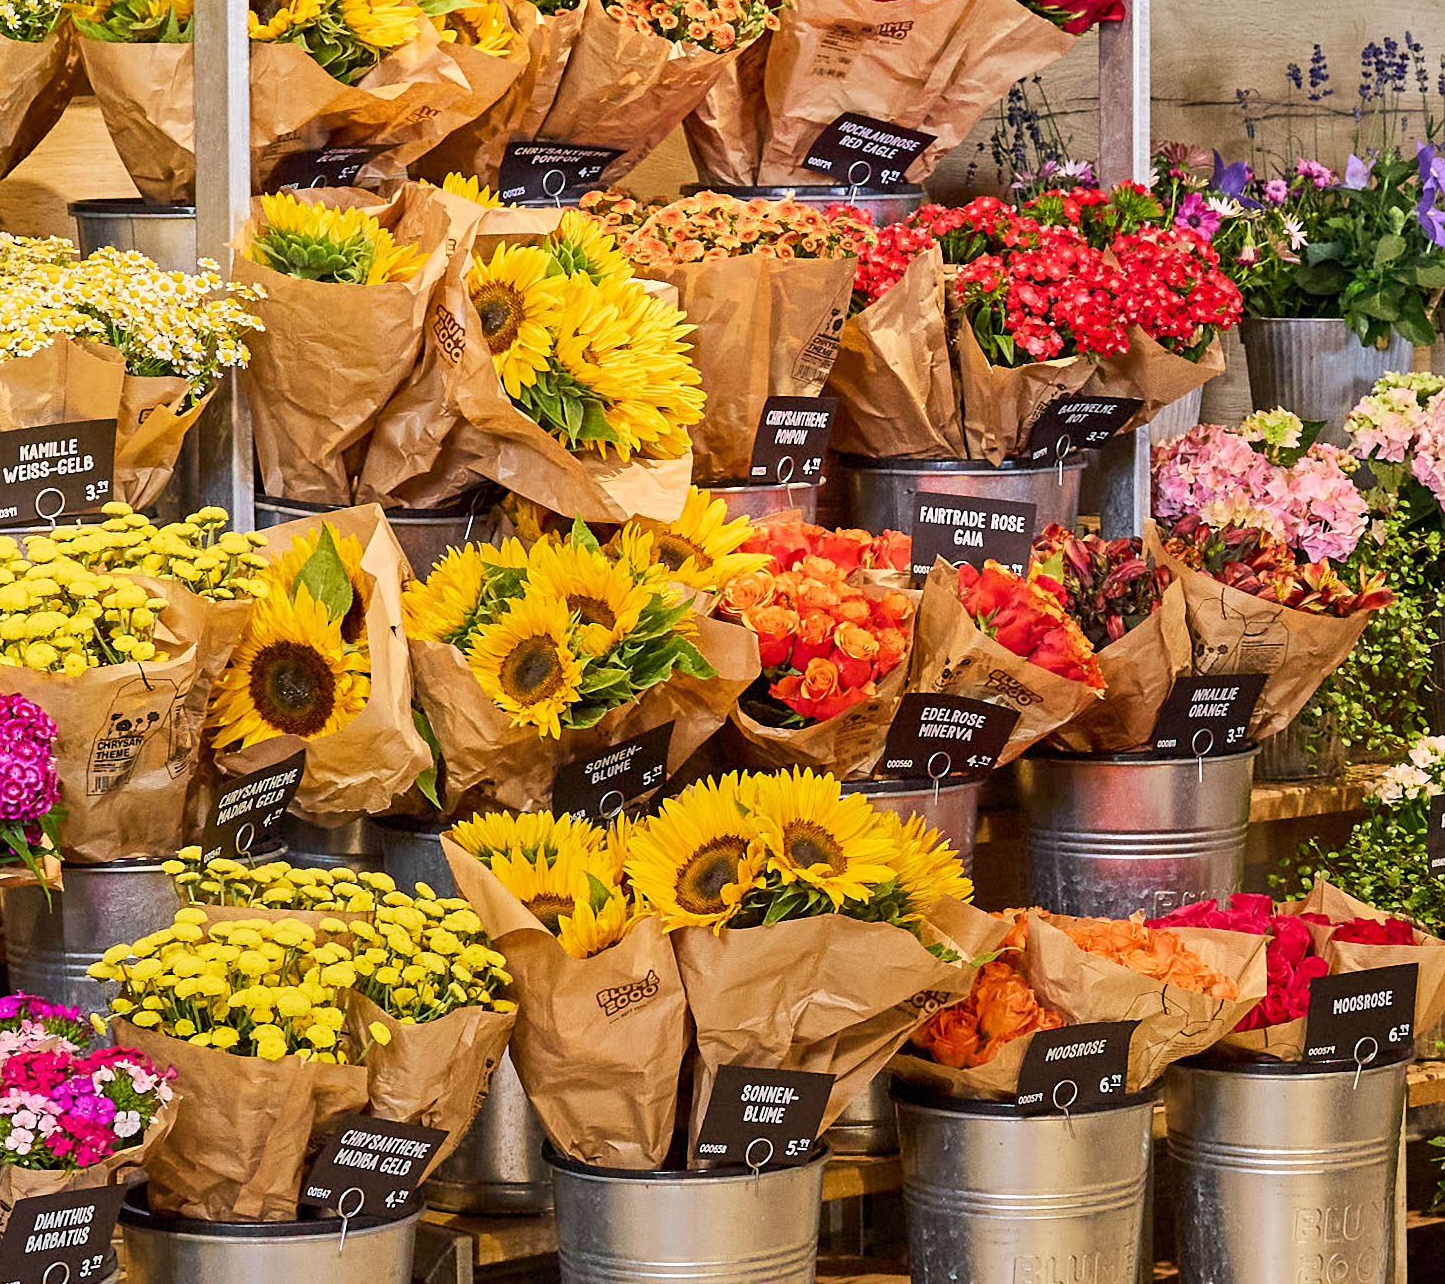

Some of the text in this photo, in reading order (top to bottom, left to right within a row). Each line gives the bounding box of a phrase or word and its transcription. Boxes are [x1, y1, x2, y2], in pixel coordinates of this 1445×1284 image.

[838, 120, 921, 153] HOCHLANDROSE
[838, 135, 899, 160] RED EAGLE
[514, 146, 612, 158] CHRYSANTHEME
[531, 154, 582, 165] POMPON
[766, 410, 830, 429] CHRYSANTHEME
[1057, 404, 1118, 417] BARTNELKE
[1065, 413, 1088, 423] ROT
[775, 428, 809, 446] POMPON
[19, 438, 78, 462] KAMILLE
[2, 455, 95, 485] WEISS-GELB
[85, 480, 110, 502] 3.99
[919, 506, 1025, 533] FAIRTRADE ROSE
[953, 529, 984, 548] GAIA
[920, 706, 987, 729] EDELROSE
[1188, 702, 1228, 718] ORANGE
[97, 737, 144, 751] CHRYSAN
[918, 723, 974, 742] MINERVA
[96, 748, 131, 760] THEME
[585, 744, 643, 775] SONNEN-
[591, 758, 631, 785] BLUME
[218, 768, 298, 810] CHRYSANTHEME
[216, 788, 285, 826] MADIBA GELB
[596, 970, 660, 1007] BLUME
[605, 982, 659, 1017] 2000
[1333, 990, 1393, 1015] MOOSROSE
[1388, 1024, 1410, 1043] 6.99
[1045, 1039, 1107, 1062] MOOSROSE
[740, 1084, 800, 1105] SONNEN-
[1098, 1074, 1123, 1093] 6.99
[743, 1105, 786, 1125] BLUME
[340, 1129, 431, 1160] CHRYSANTHEME
[785, 1138, 811, 1156] 5.99
[333, 1147, 412, 1176] MADIBA GELB
[384, 1189, 409, 1208] 4.99
[34, 1205, 95, 1232] DIANTHUS
[24, 1226, 91, 1254] BARBATUS
[79, 1255, 103, 1278] 3.99
